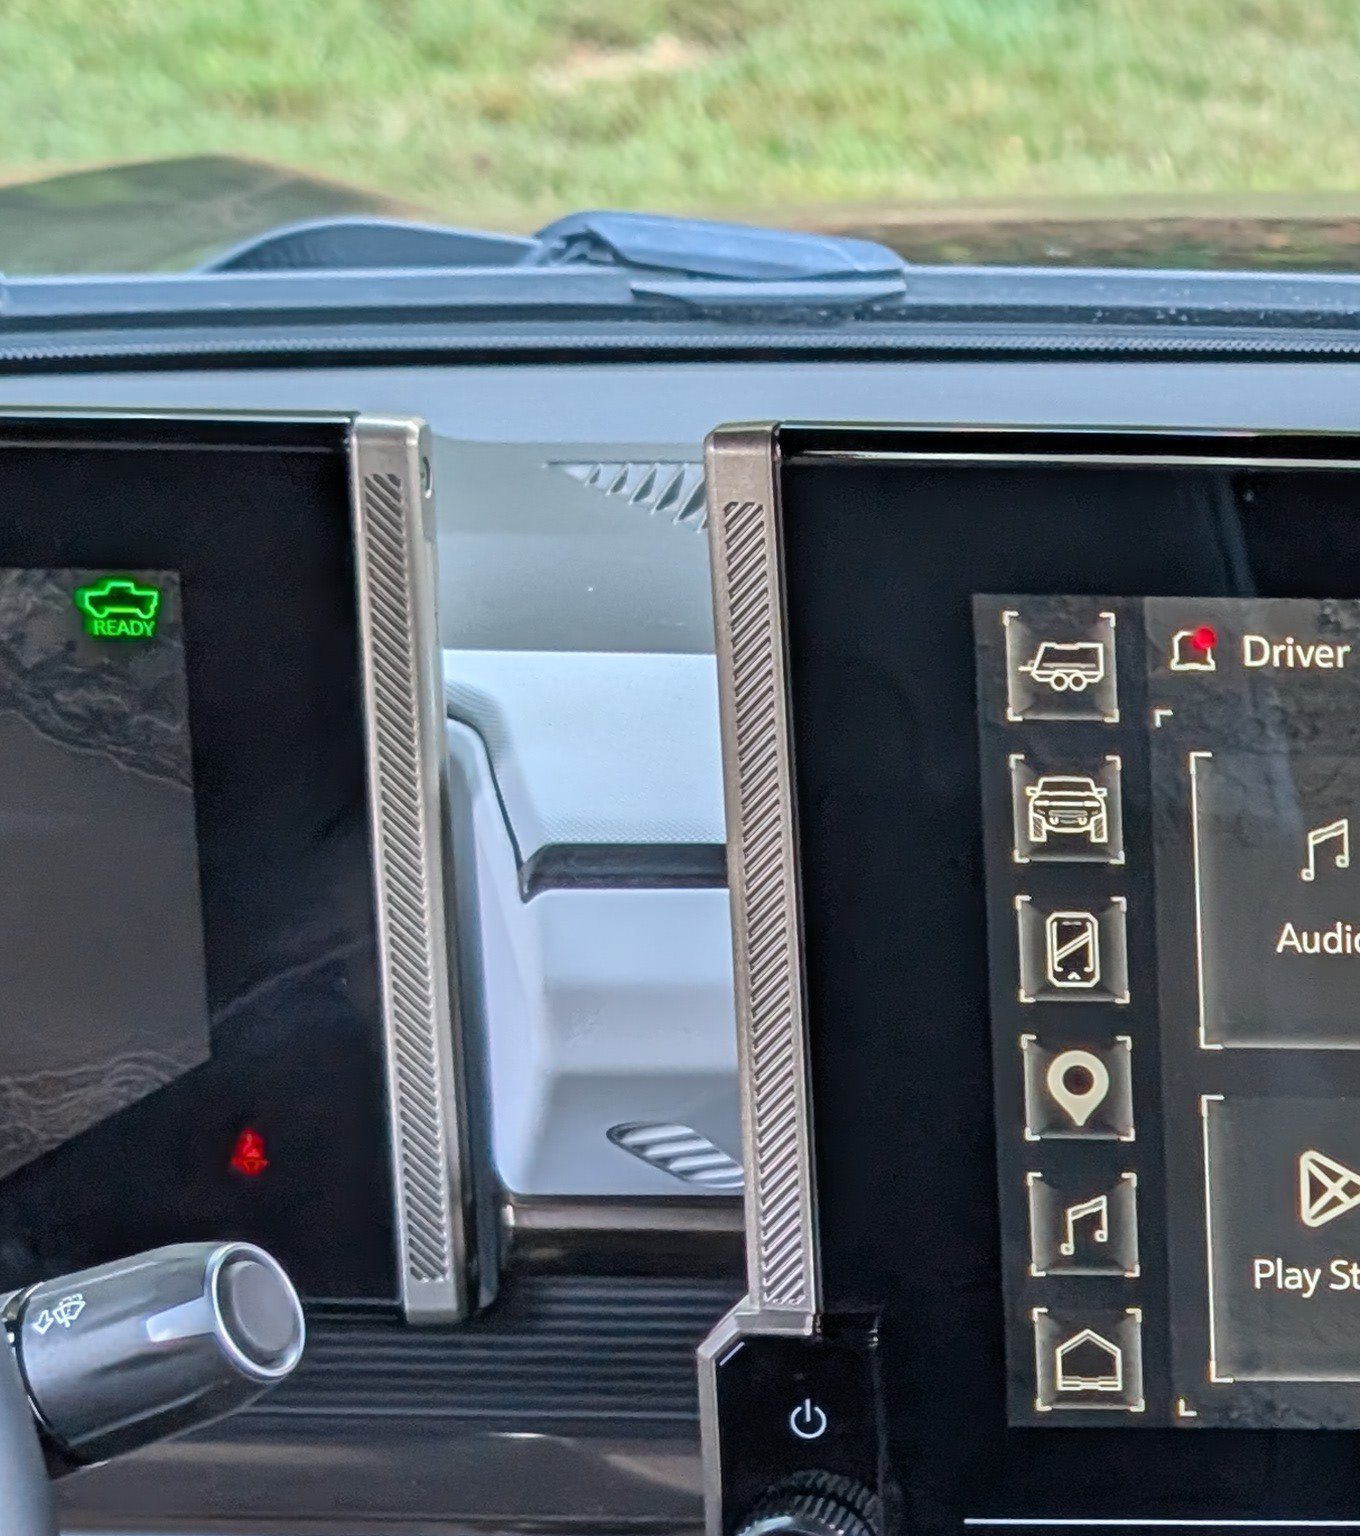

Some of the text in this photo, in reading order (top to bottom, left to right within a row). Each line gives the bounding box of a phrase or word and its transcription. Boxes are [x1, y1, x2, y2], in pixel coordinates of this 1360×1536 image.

[93, 620, 156, 637] READY
[1242, 634, 1351, 669] Driver
[1253, 1257, 1322, 1299] Play
